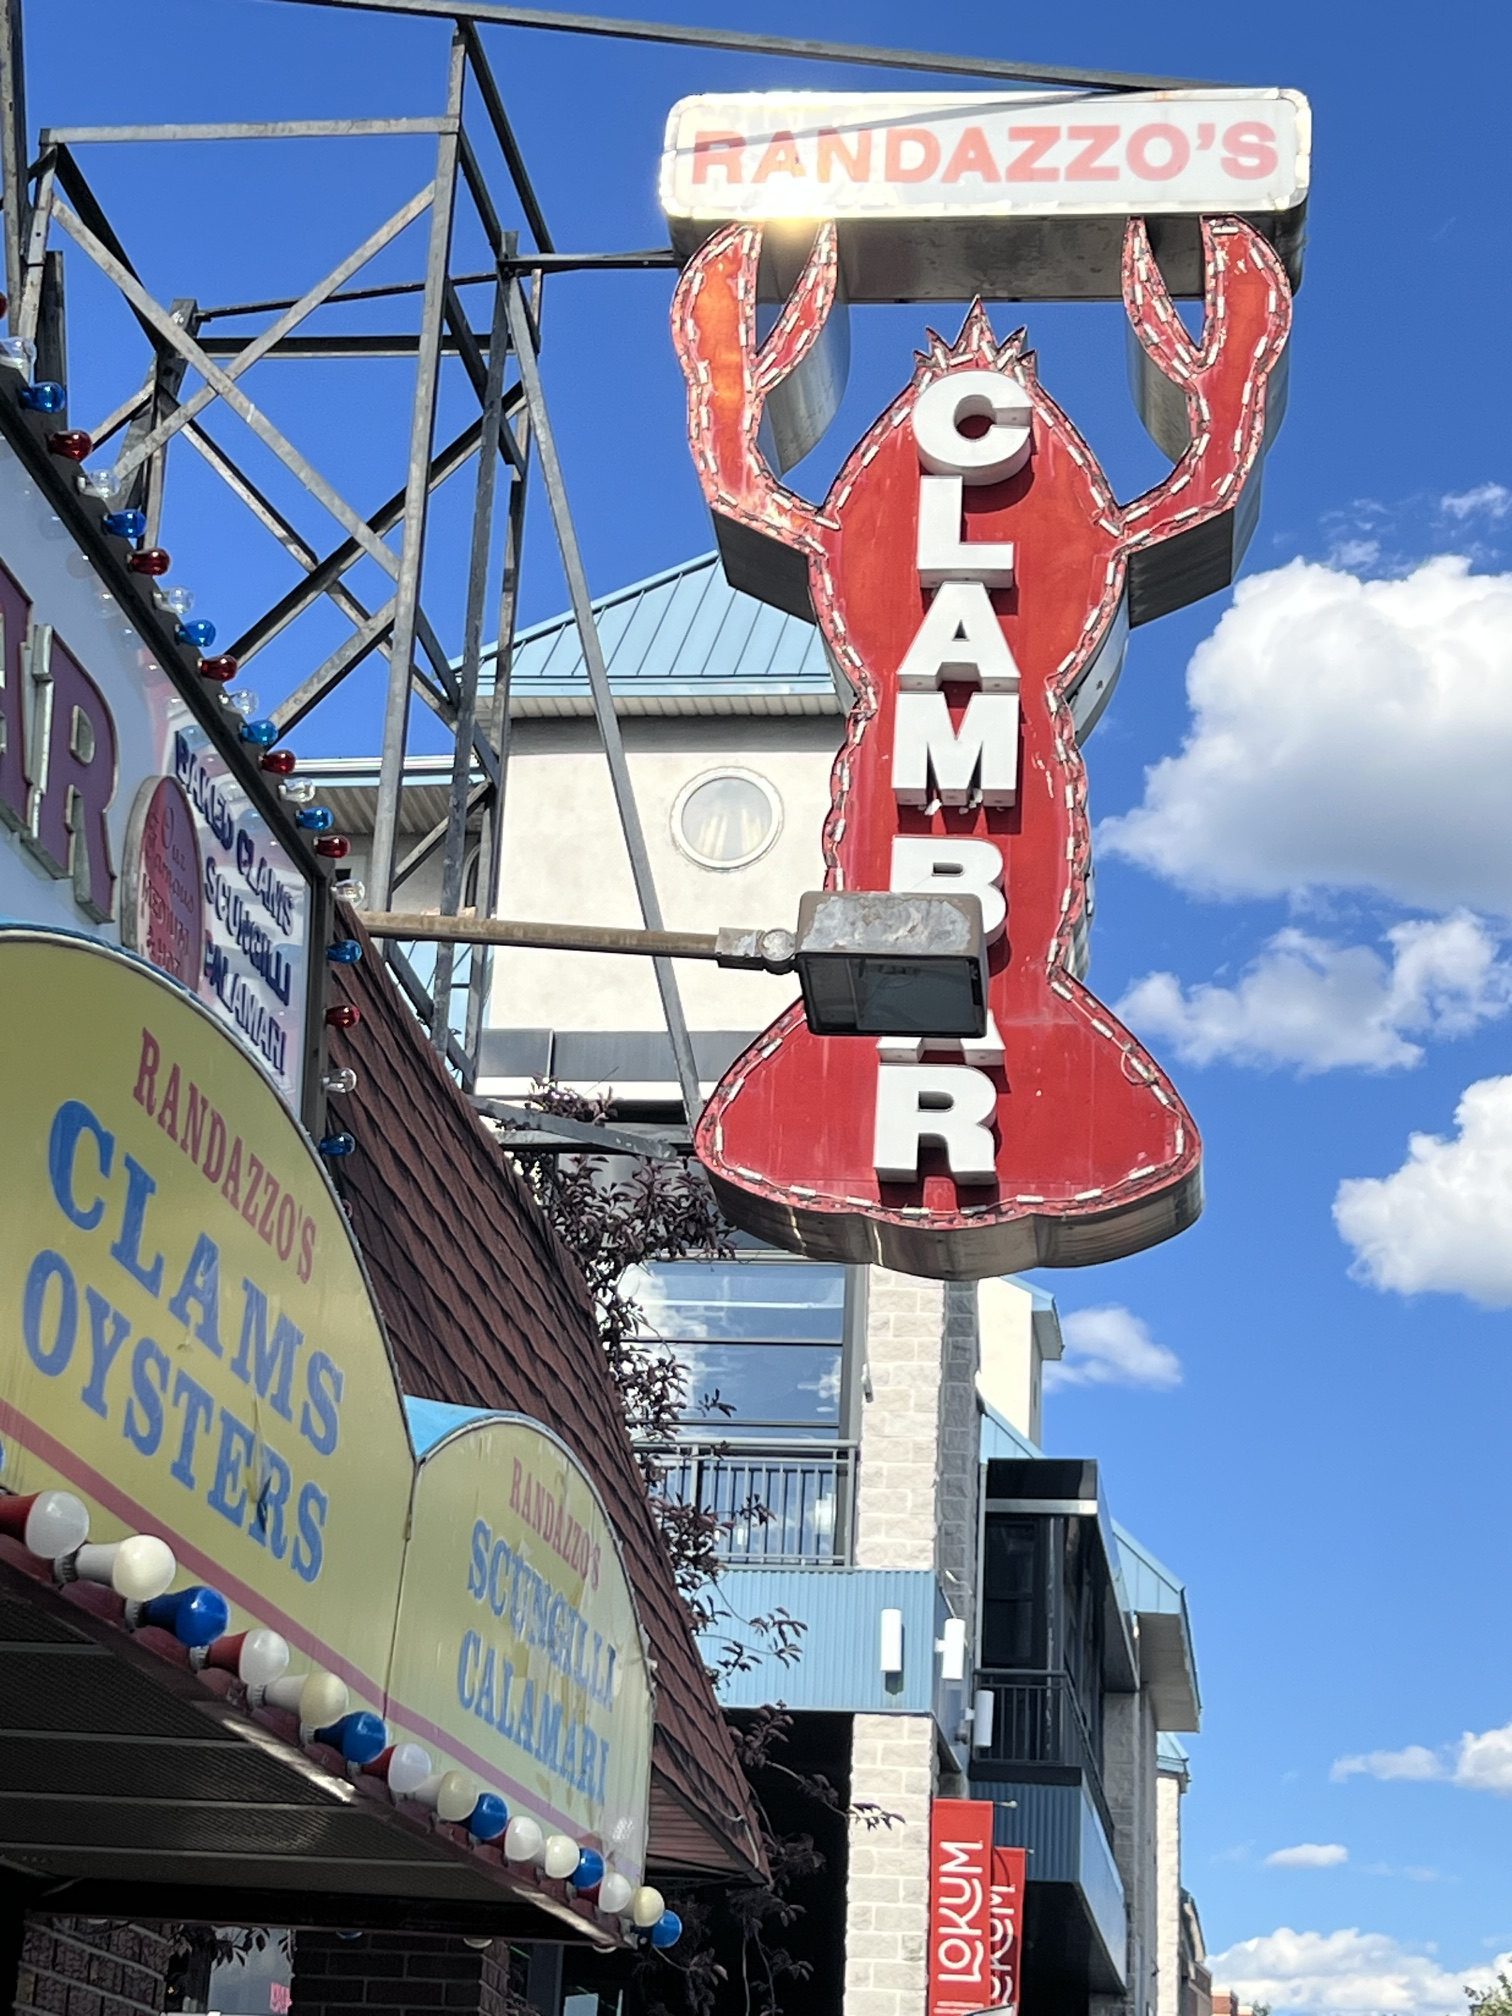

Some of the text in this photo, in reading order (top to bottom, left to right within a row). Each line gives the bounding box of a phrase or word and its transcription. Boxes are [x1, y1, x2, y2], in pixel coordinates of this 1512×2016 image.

[691, 121, 1278, 184] RANDAZZO'S
[892, 370, 1033, 806] CLAM
[174, 731, 293, 937] BAKED CLAMS
[133, 1027, 317, 1284] RANDAZZO'S
[48, 1099, 345, 1457] CLAMS
[22, 1249, 329, 1583] OYSTERS
[467, 1517, 616, 1712] SCUNGILLI
[510, 1457, 600, 1591] RANDAZZO'S
[457, 1628, 609, 1806] CALAMARI
[937, 1840, 984, 1982] LOKUM
